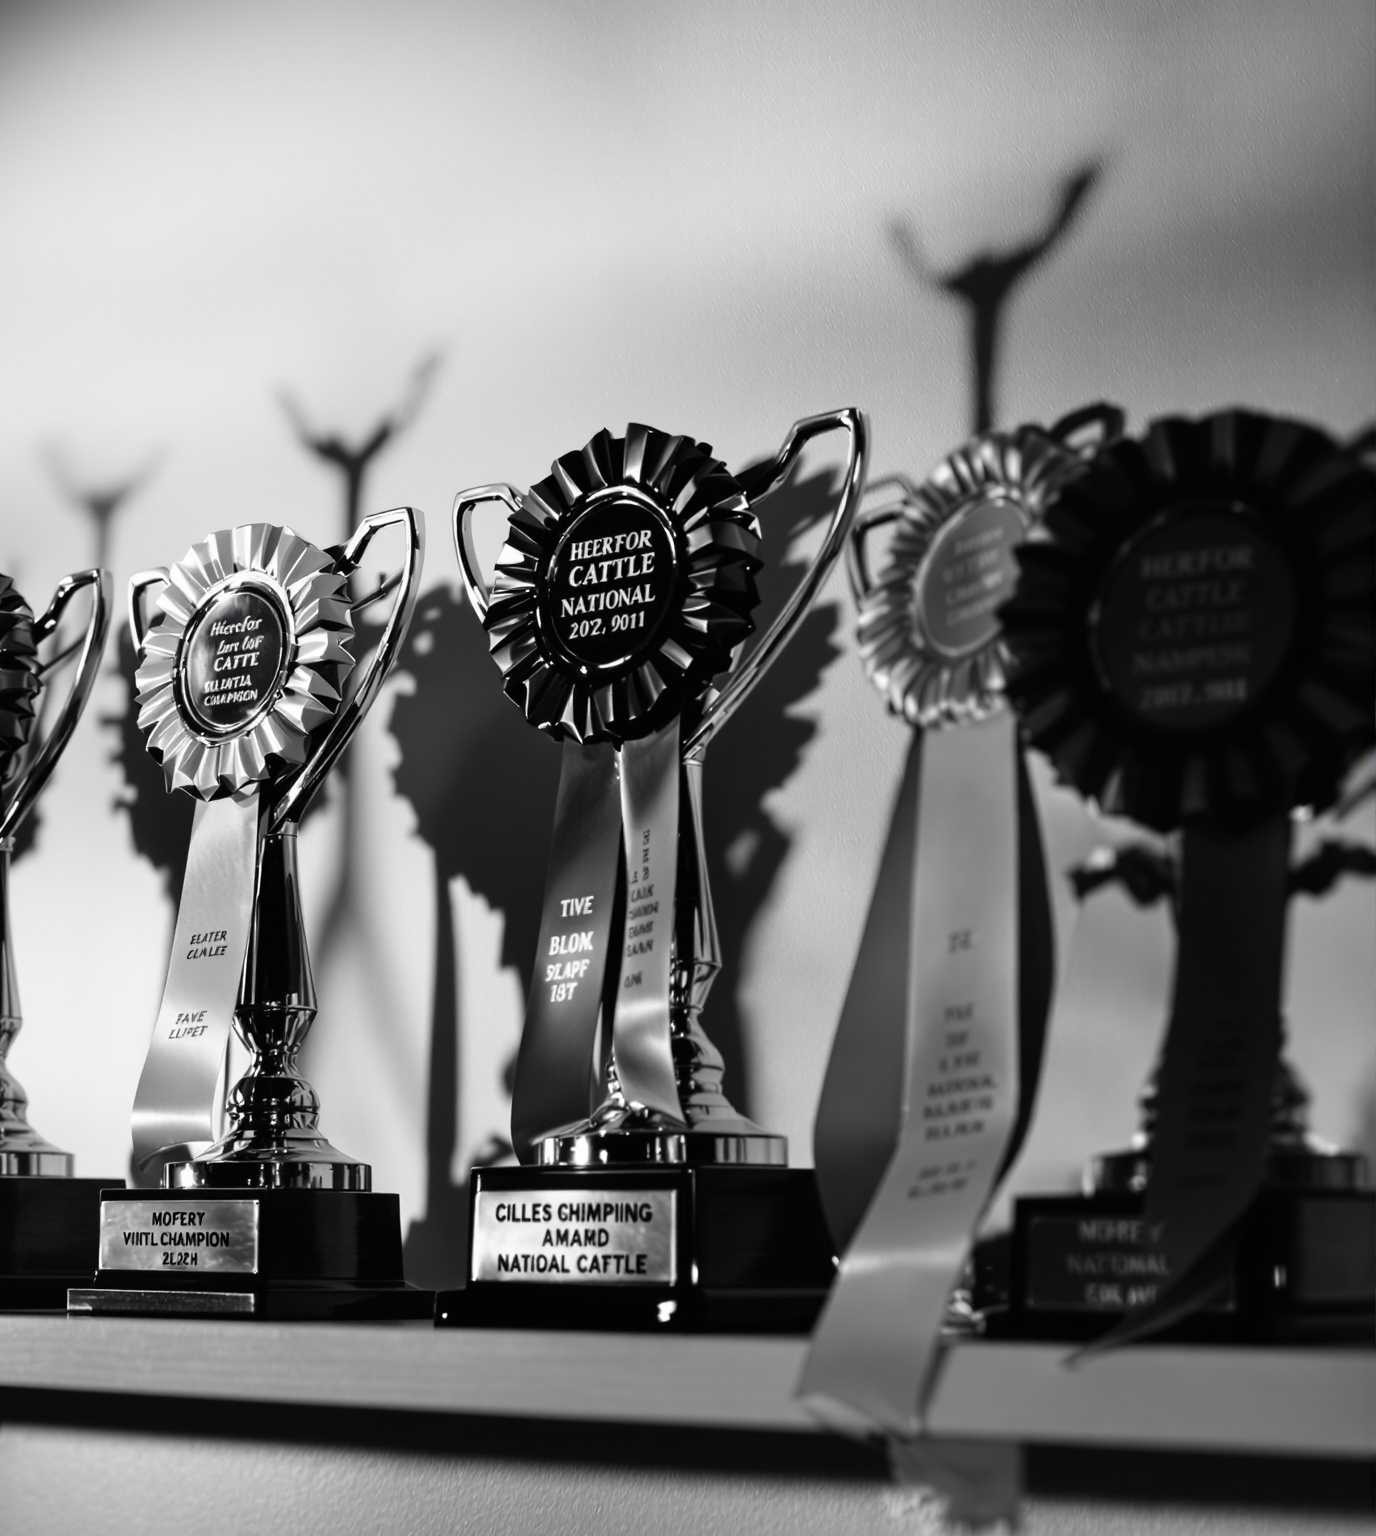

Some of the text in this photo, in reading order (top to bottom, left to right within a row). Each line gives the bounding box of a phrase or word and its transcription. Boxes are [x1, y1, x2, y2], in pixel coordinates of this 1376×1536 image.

[569, 529, 653, 562] HEERFOR
[568, 552, 656, 587] CATTLE
[560, 584, 656, 618] NATIONAL
[611, 610, 645, 633] 9011
[560, 895, 594, 917] TIVE
[160, 1231, 230, 1248] CHAMPION
[497, 1254, 571, 1274] NATIOAL
